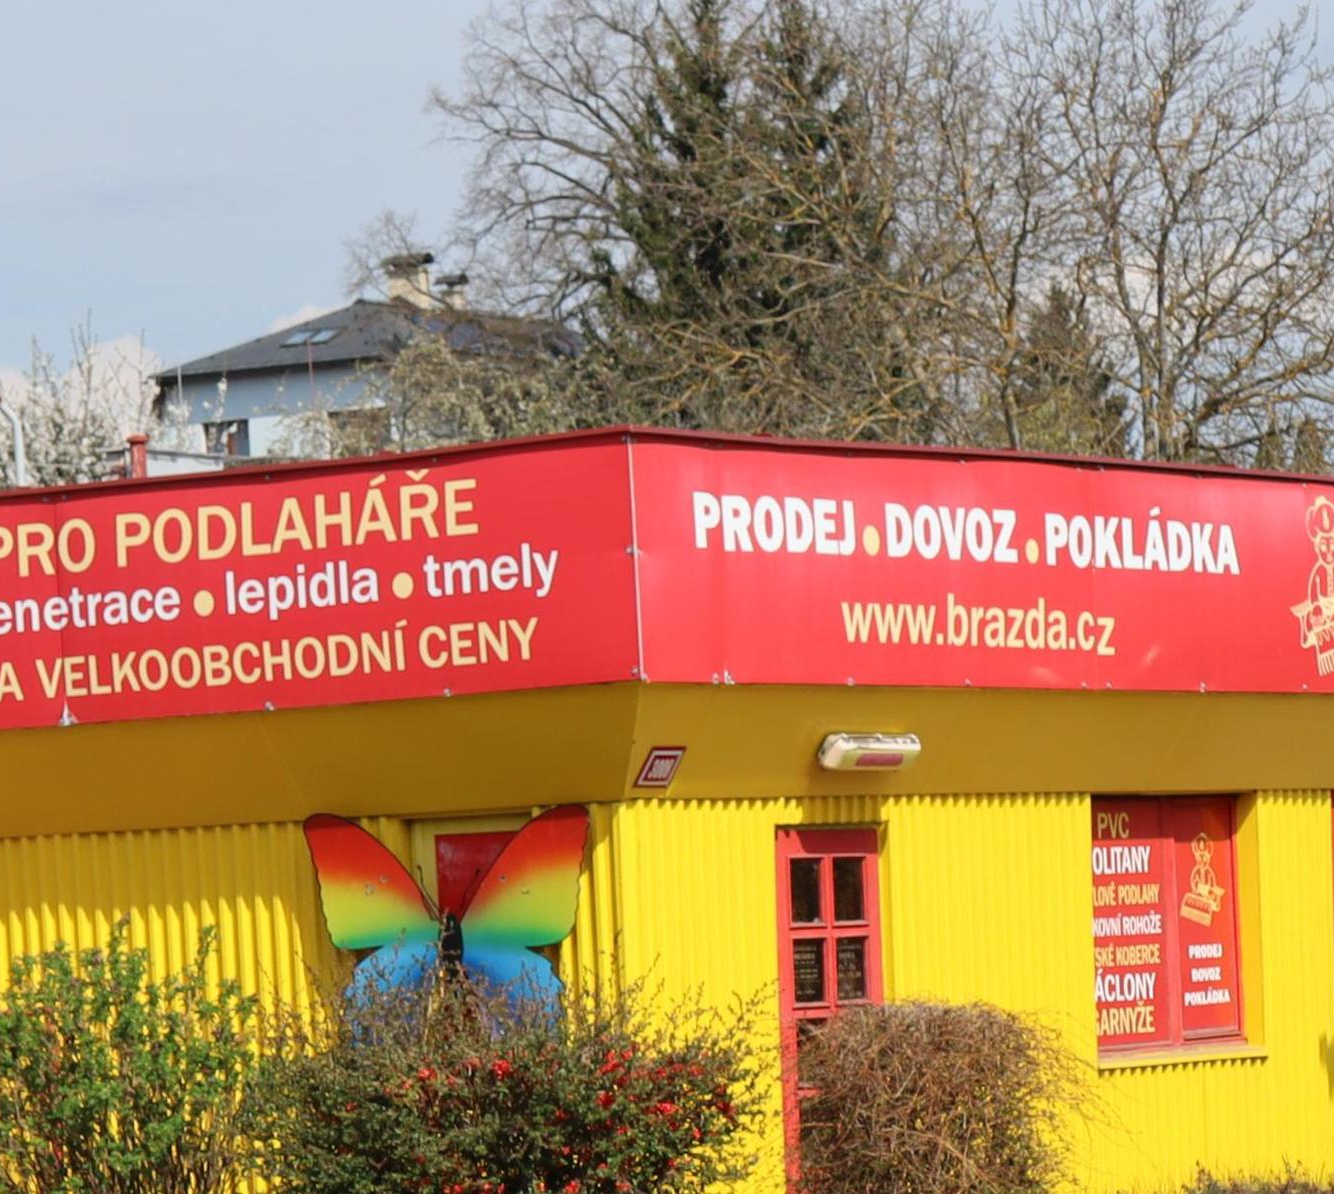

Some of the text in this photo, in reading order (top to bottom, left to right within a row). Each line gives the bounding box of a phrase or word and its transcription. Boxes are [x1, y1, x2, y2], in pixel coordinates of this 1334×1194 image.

[115, 468, 480, 568] PODLAHÁŘE
[691, 490, 1242, 576] PRODEJ DOVOZ POKLÁDKA
[225, 559, 380, 621] lepidla
[423, 542, 559, 598] tmely
[840, 592, 1116, 656] www.brazda.cz
[34, 619, 406, 700] VELKOOBCHODNÍ
[418, 617, 539, 669] CENY
[1097, 812, 1130, 840] PVC
[1092, 845, 1151, 875] OLITANY
[1092, 881, 1161, 907] LOVÉ PODLAHY
[1092, 910, 1163, 938] KOVNÍ ROHOŽE
[1095, 942, 1161, 968] SKÉ KOBERCE
[1188, 943, 1223, 960] PRODEJ
[1095, 968, 1157, 1004] ÁCLONY
[1184, 986, 1231, 1007] POKLÁDKA
